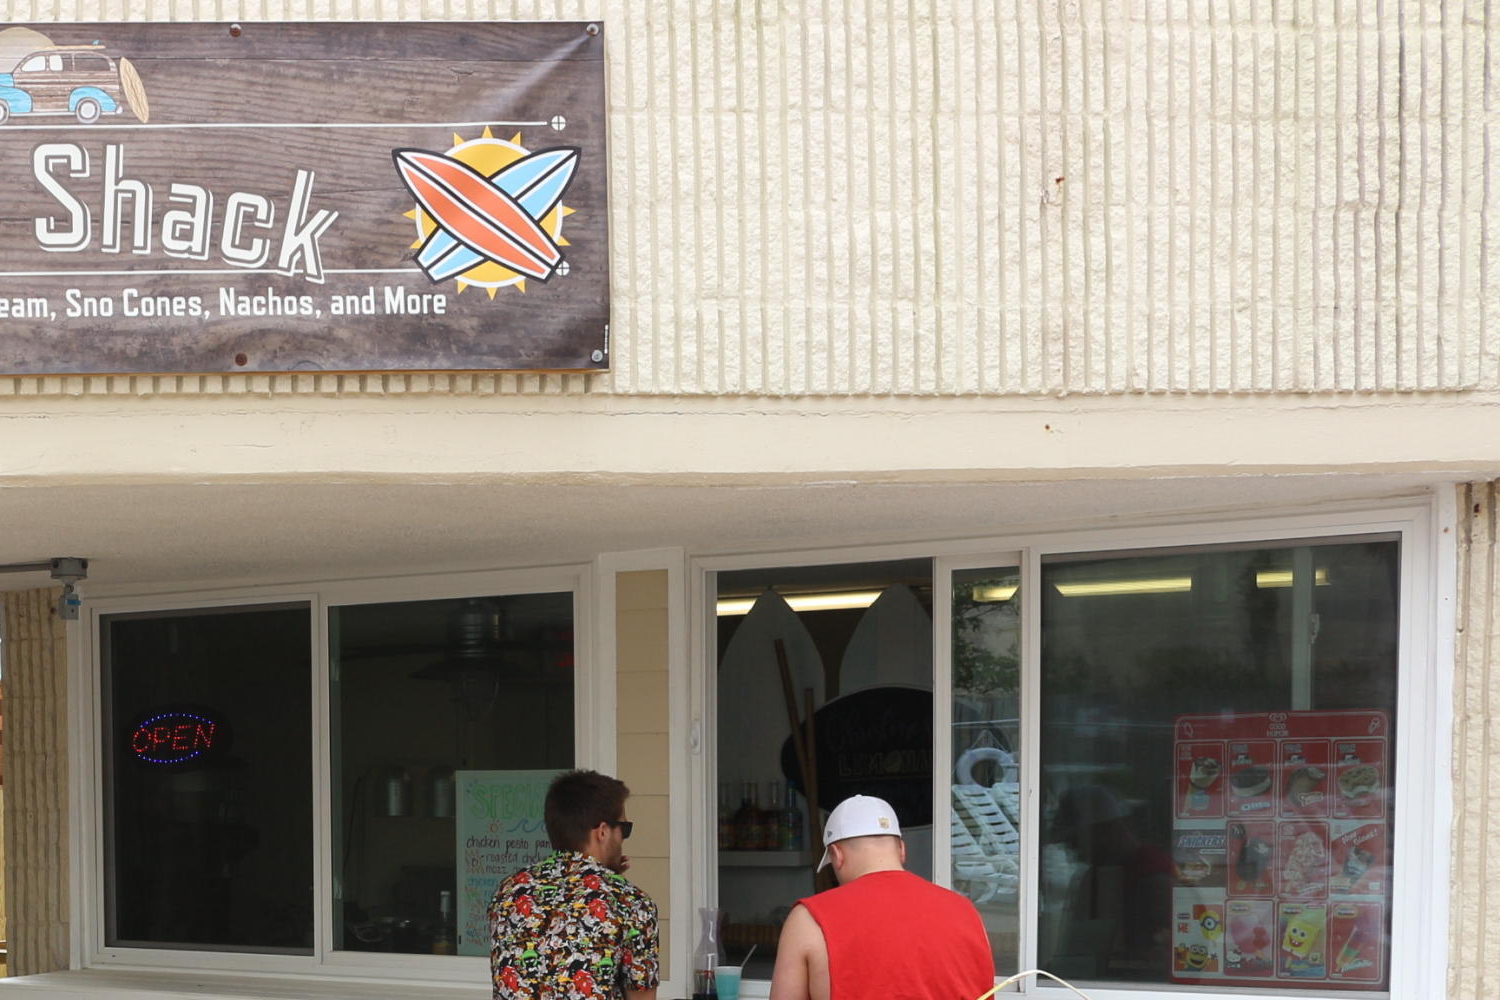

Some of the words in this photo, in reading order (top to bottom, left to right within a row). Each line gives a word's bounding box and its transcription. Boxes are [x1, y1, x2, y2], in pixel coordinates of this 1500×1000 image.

[33, 143, 340, 284] Shack
[65, 288, 114, 318] Sno
[123, 288, 210, 320] Cones,
[219, 286, 321, 319] Nachos,
[330, 286, 376, 316] and
[384, 286, 447, 315] More
[132, 723, 216, 753] OPEN
[535, 839, 552, 857] pan
